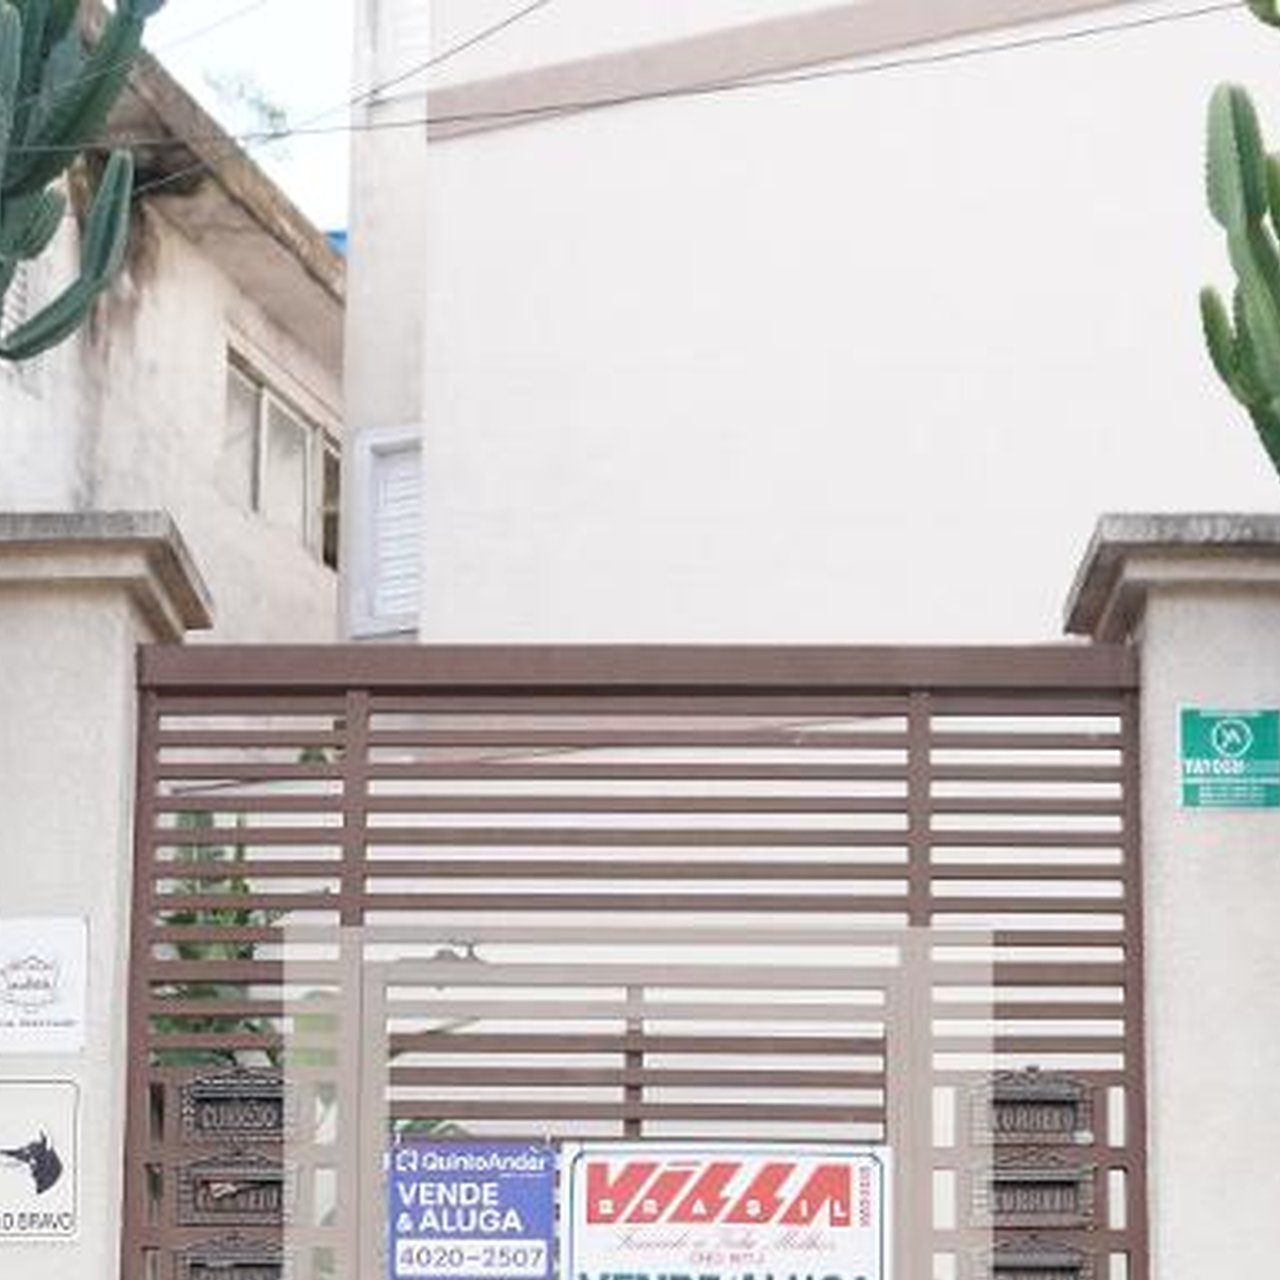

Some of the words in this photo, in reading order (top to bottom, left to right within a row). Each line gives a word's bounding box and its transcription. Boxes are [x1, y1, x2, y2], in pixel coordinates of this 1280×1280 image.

[396, 1182, 499, 1206] VENDE
[18, 1212, 72, 1231] BRAVO
[396, 1212, 413, 1232] &
[418, 1208, 522, 1232] ALUGA
[399, 1248, 544, 1268] 4020-2507
